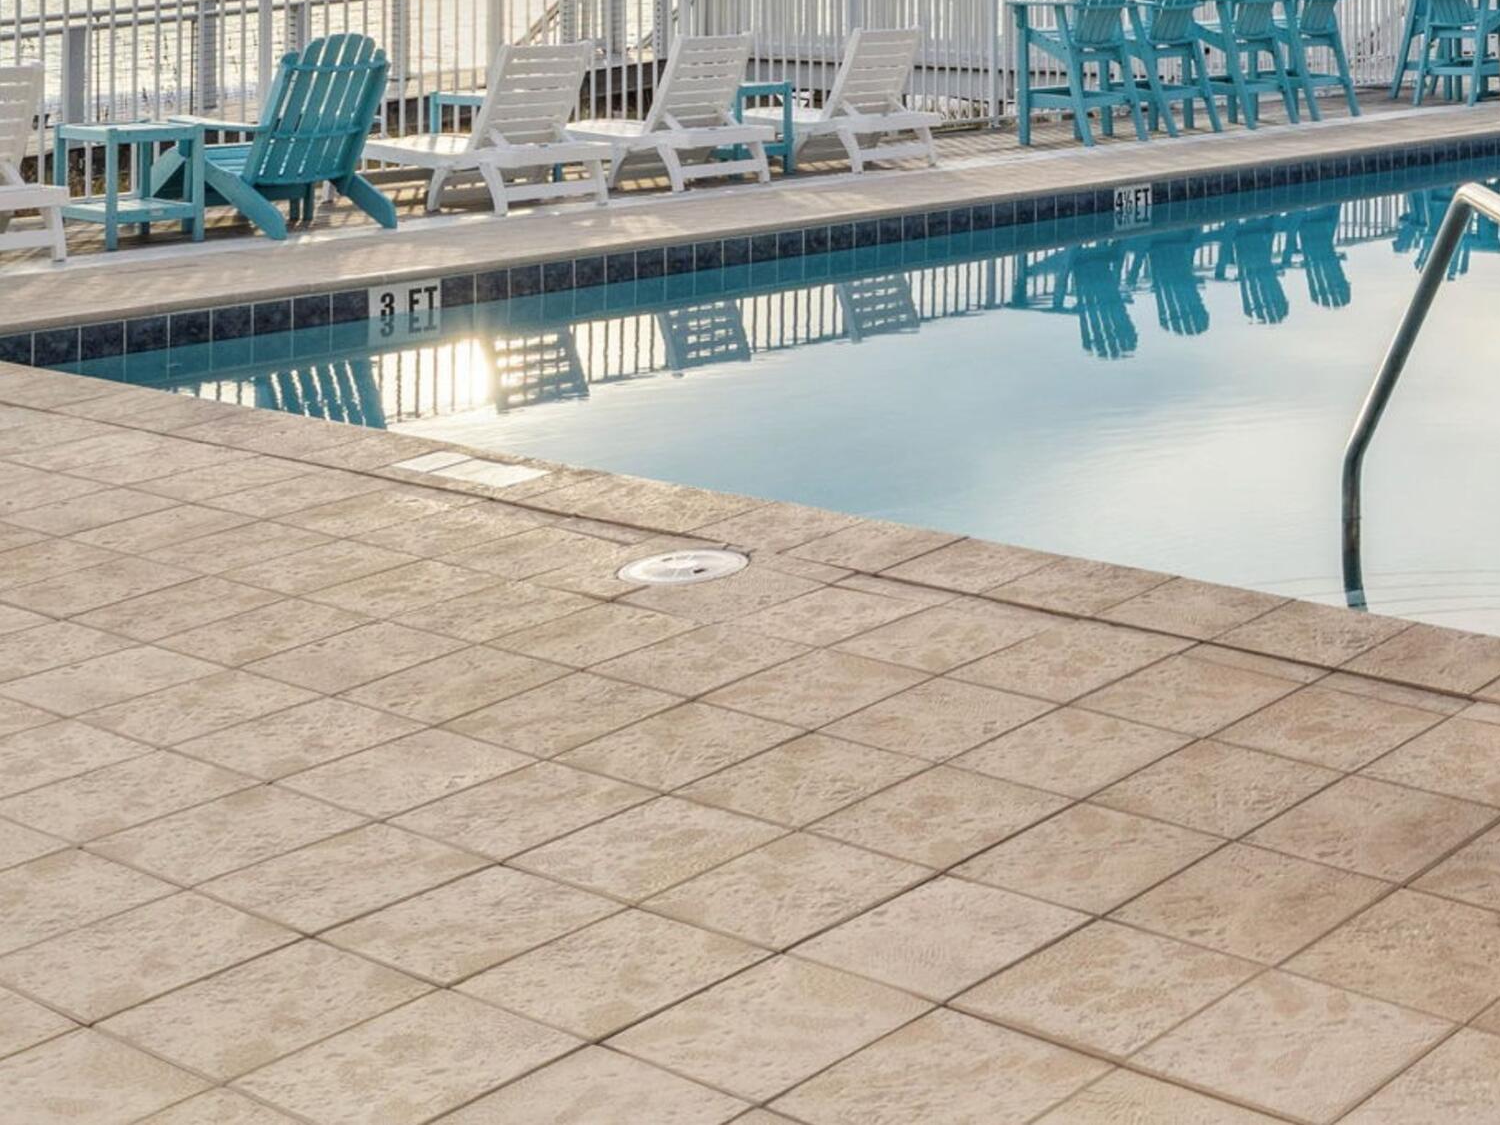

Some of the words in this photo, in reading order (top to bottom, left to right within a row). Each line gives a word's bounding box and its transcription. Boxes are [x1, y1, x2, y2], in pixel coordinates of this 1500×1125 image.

[1135, 187, 1149, 206] FT
[380, 292, 395, 316] 3
[408, 286, 438, 312] FT
